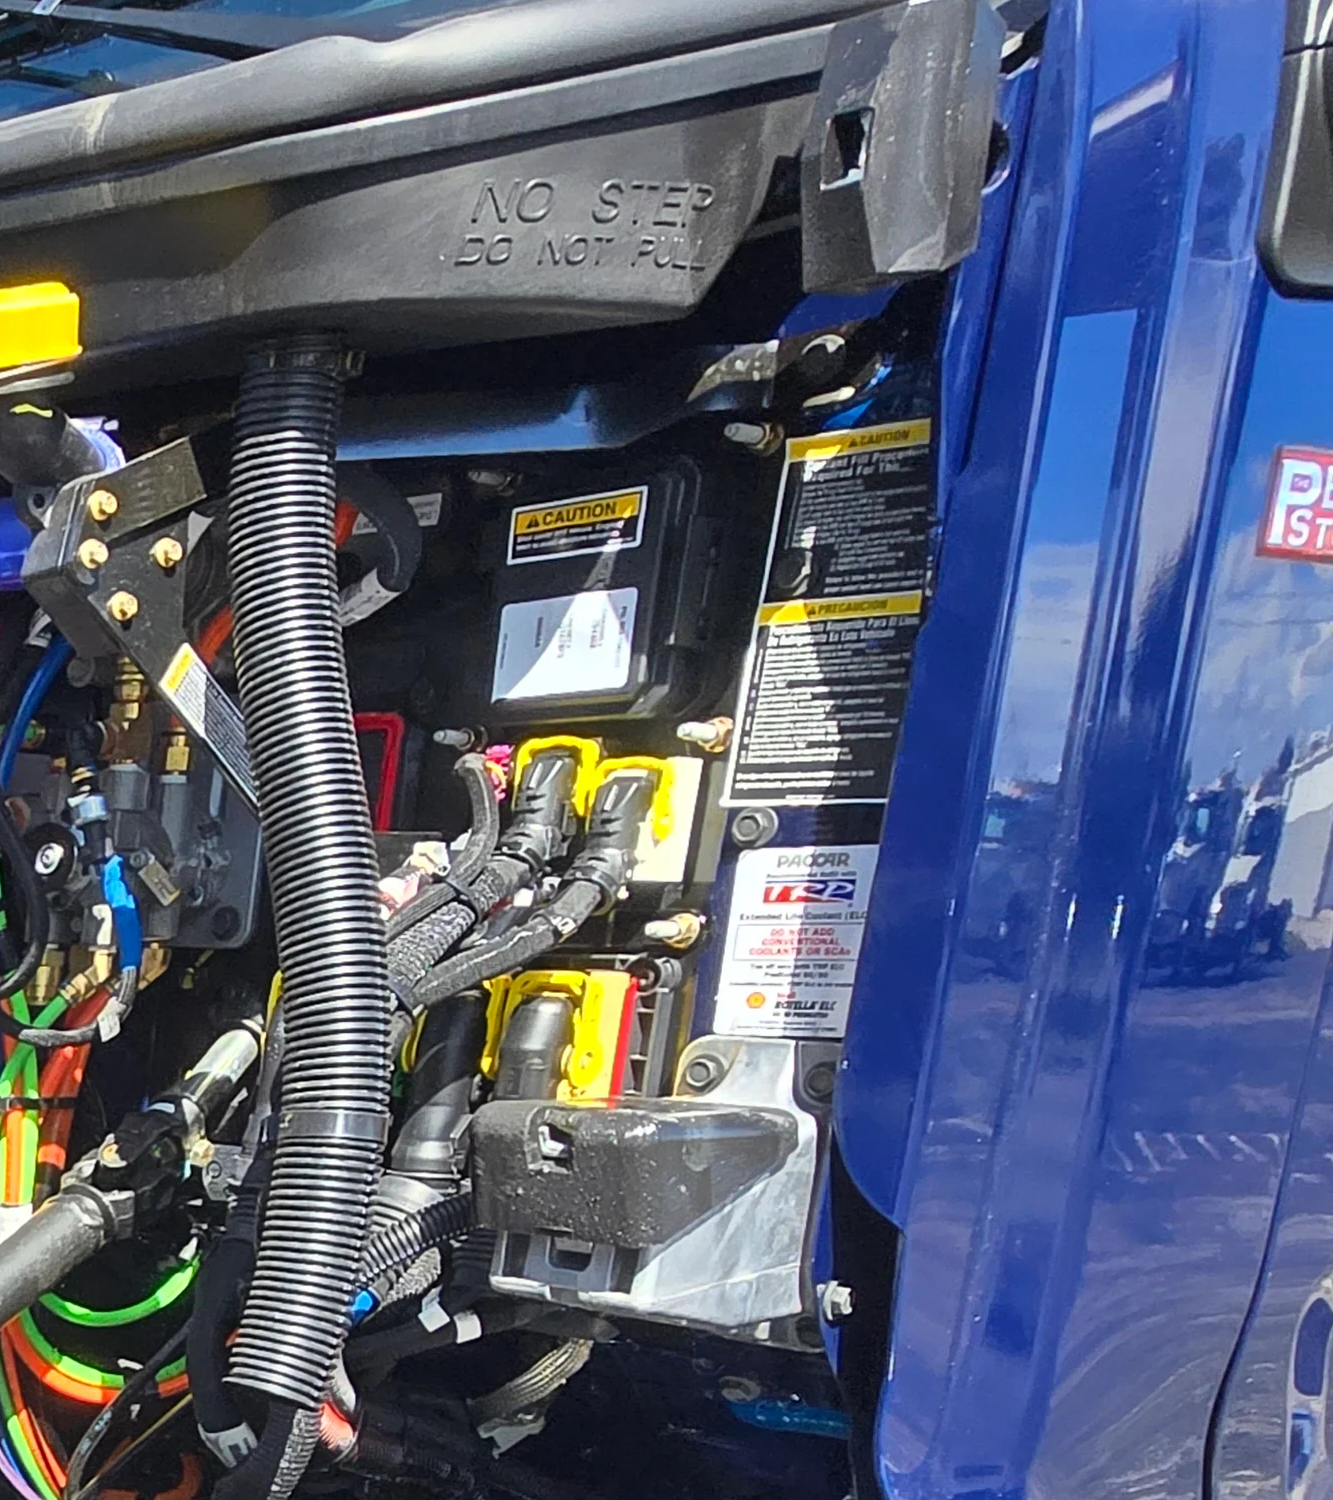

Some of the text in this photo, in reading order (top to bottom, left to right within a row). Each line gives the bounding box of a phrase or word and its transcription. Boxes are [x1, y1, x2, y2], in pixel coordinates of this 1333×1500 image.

[471, 178, 715, 229] NO STEP
[454, 234, 513, 267] DO
[536, 234, 615, 267] NOT
[542, 502, 617, 526] CAUTION
[777, 852, 851, 869] PACCAR
[765, 880, 855, 903] TRP
[812, 927, 835, 937] ADD
